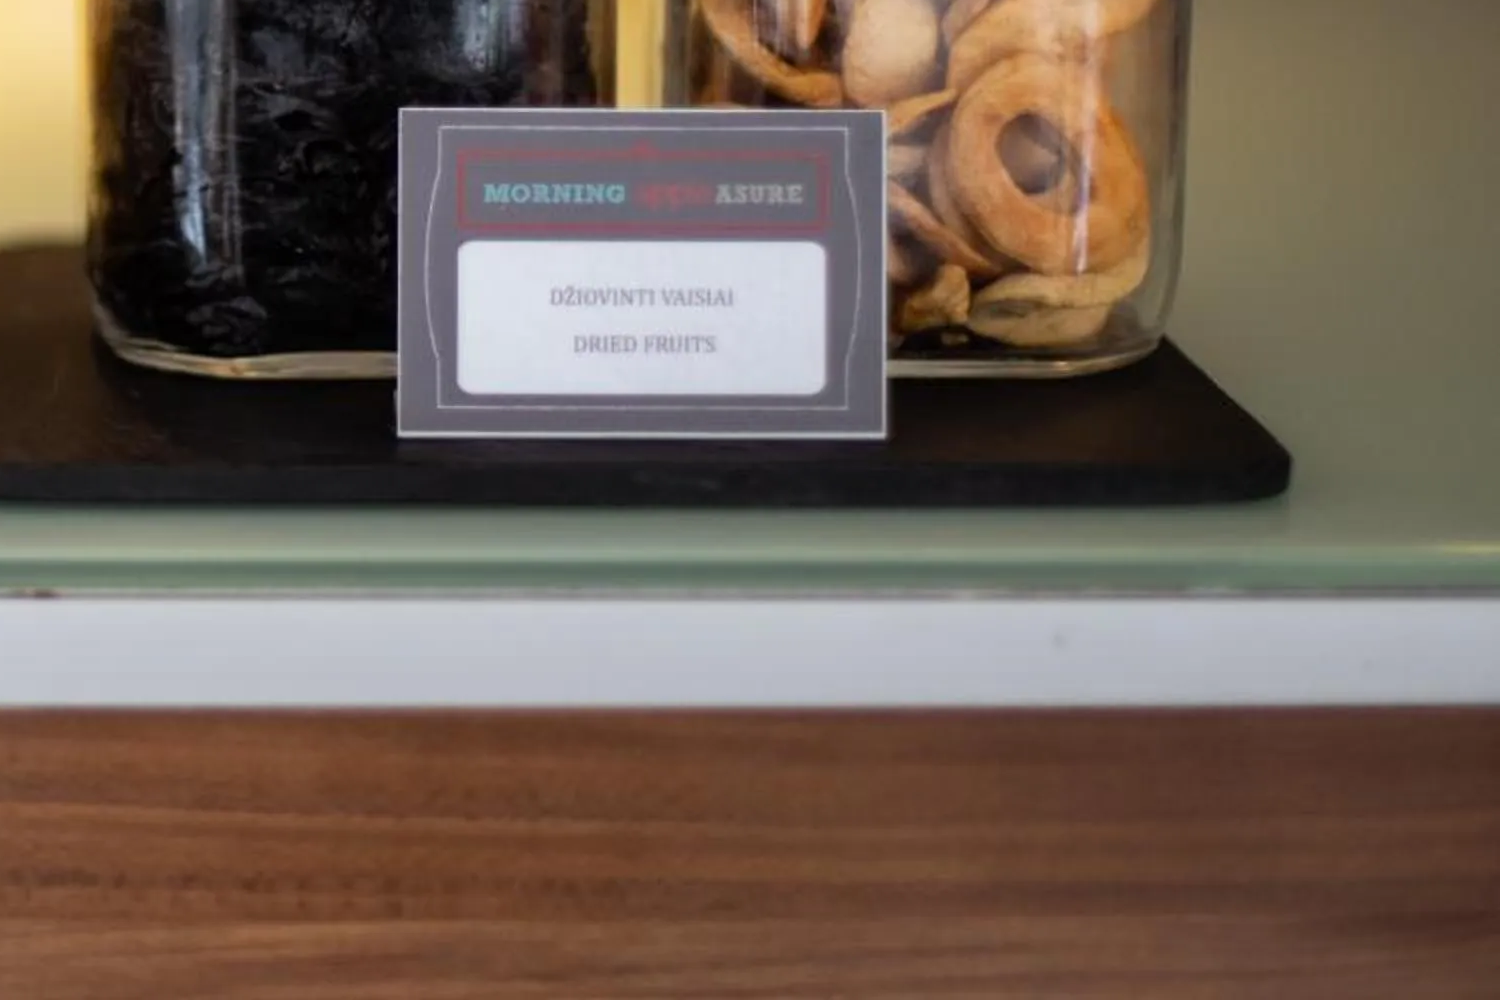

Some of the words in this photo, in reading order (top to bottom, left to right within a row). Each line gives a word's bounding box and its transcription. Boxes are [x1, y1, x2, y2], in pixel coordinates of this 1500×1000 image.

[483, 183, 626, 203] MORNING
[549, 284, 656, 307] DŽIOVINTI
[662, 289, 735, 307] VAISIAI
[573, 335, 638, 354] DRIED
[644, 336, 716, 354] FRUITS
